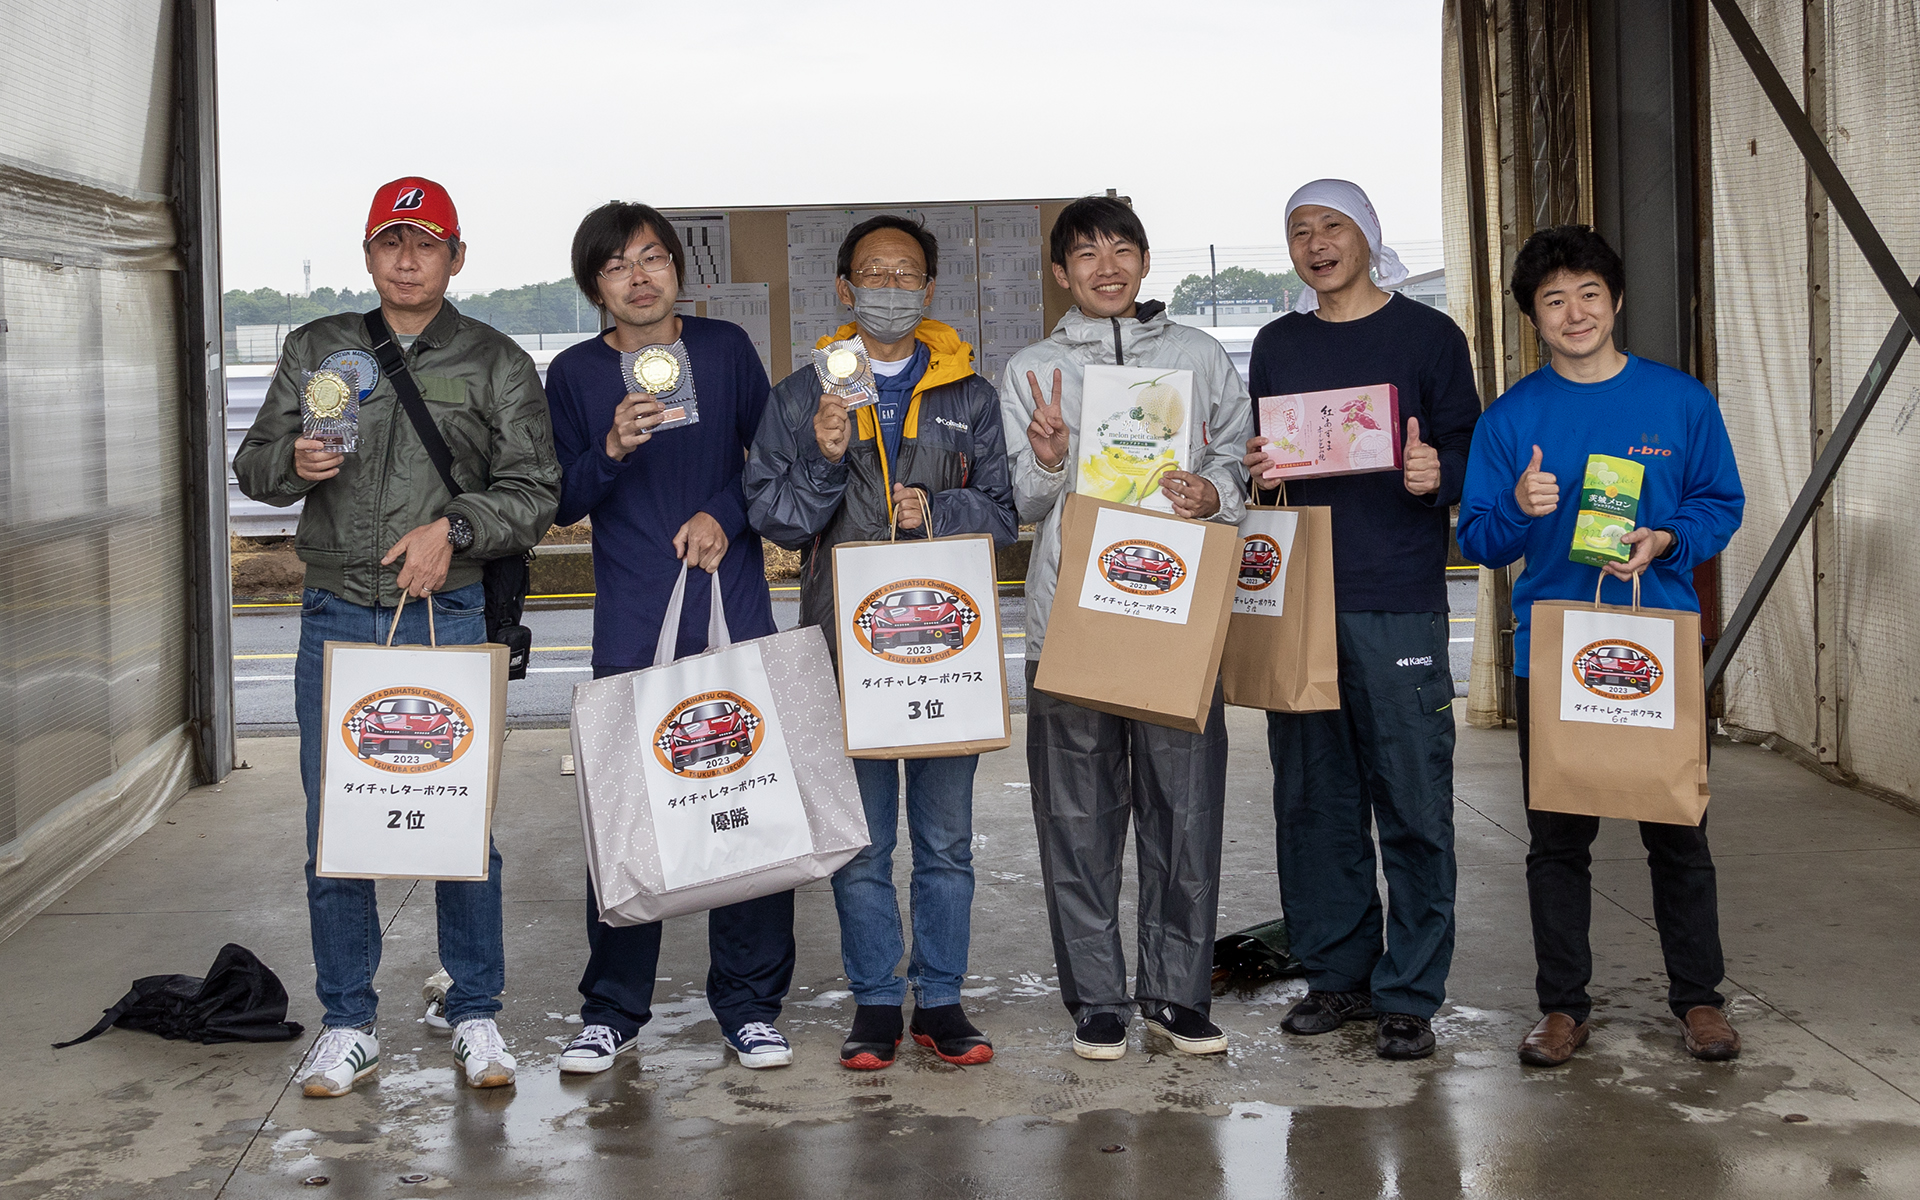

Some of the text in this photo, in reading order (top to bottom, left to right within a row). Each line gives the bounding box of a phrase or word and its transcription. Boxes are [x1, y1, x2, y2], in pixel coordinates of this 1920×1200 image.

[882, 409, 895, 419] GAP
[941, 418, 968, 430] Columbia
[1588, 494, 1631, 508] 茨城メロン
[1130, 540, 1155, 548] DAIHATSU
[1129, 582, 1148, 590] 2023
[858, 590, 883, 612] D-SPORT
[890, 580, 925, 591] DAIHATSU
[927, 580, 960, 597] Challenge
[960, 594, 972, 606] Cup
[1093, 594, 1177, 615] ダイチャレターボクラス
[887, 650, 951, 664] TSUKUBA CIRCUIT
[906, 645, 932, 655] 2023
[862, 671, 983, 689] ダイチャレターボクラス
[1608, 686, 1628, 694] 2023
[350, 694, 377, 715] D-SPORT
[384, 688, 421, 697] DAIHATSU
[422, 690, 455, 708] Challenge
[455, 707, 466, 719] Cup
[907, 698, 945, 720] 3位
[656, 709, 678, 734] D-SPORT
[681, 693, 716, 708] DAIHATSU
[741, 700, 752, 712] Cup
[1574, 703, 1663, 719] ダイチャレターボクラス
[1611, 715, 1629, 724] 6位
[393, 755, 420, 764] 2023
[705, 756, 731, 769] 2023
[373, 761, 438, 773] TSUKUBA CIRCUIT
[688, 758, 745, 778] TSUKUBA CIRCUIT
[343, 783, 469, 797] ダイチャレターボクラス
[667, 772, 778, 808] ダイチャレターボクラス
[386, 809, 426, 830] 2位
[710, 806, 750, 833] 優勝
